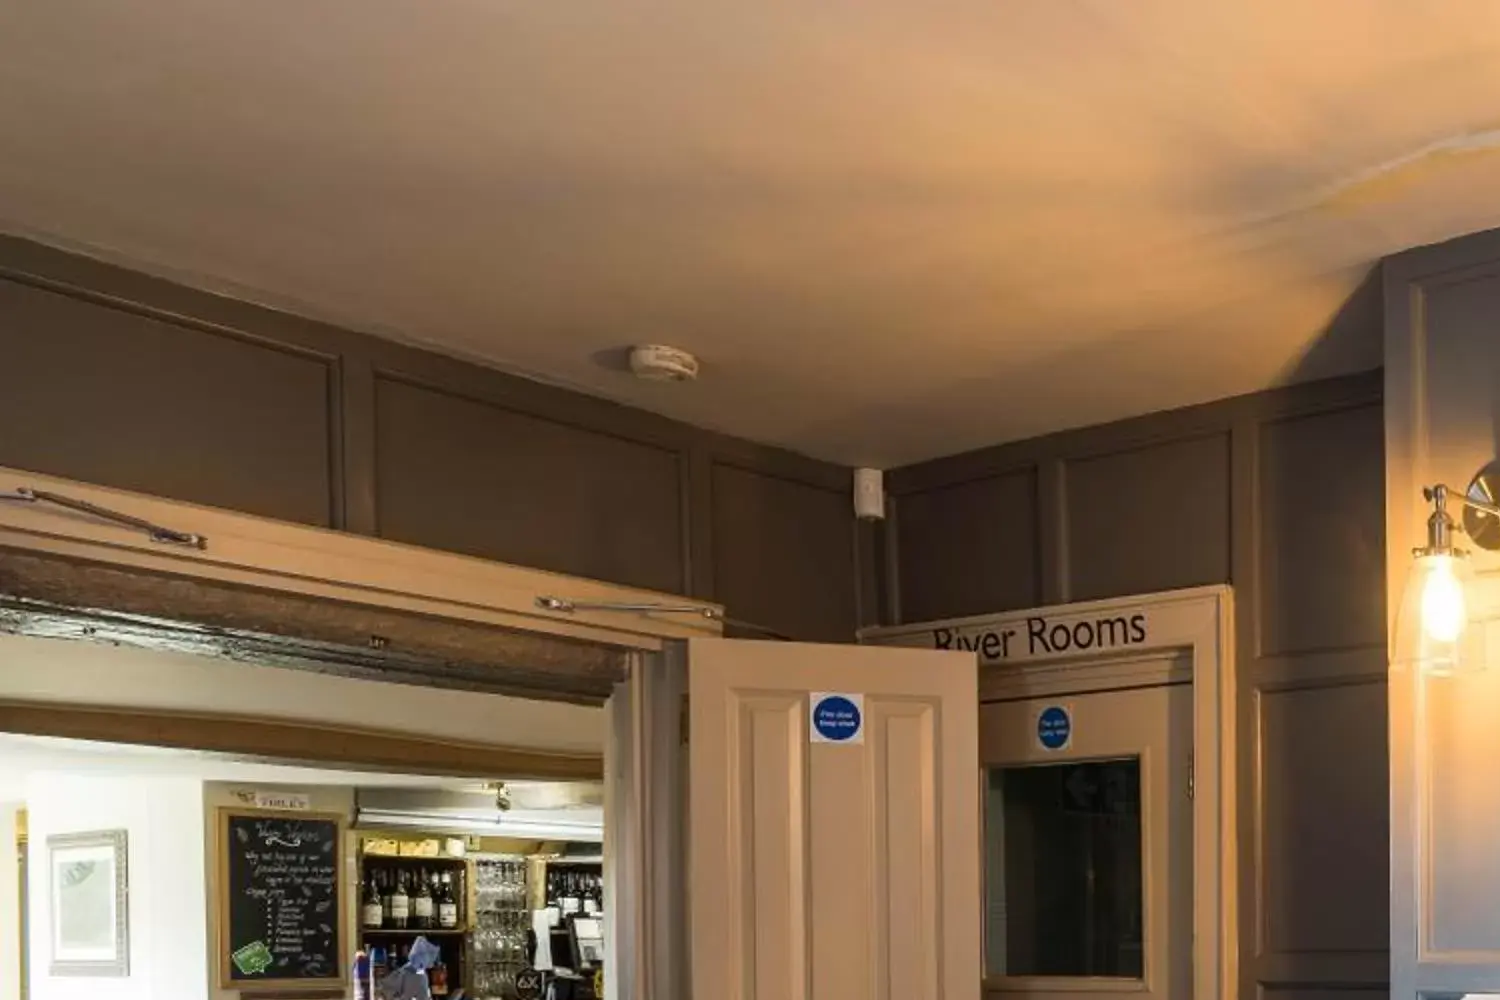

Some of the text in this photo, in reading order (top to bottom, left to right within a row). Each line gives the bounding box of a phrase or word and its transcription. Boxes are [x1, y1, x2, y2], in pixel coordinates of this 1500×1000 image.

[934, 615, 1146, 659] River Rooms
[517, 974, 539, 988] 6X
